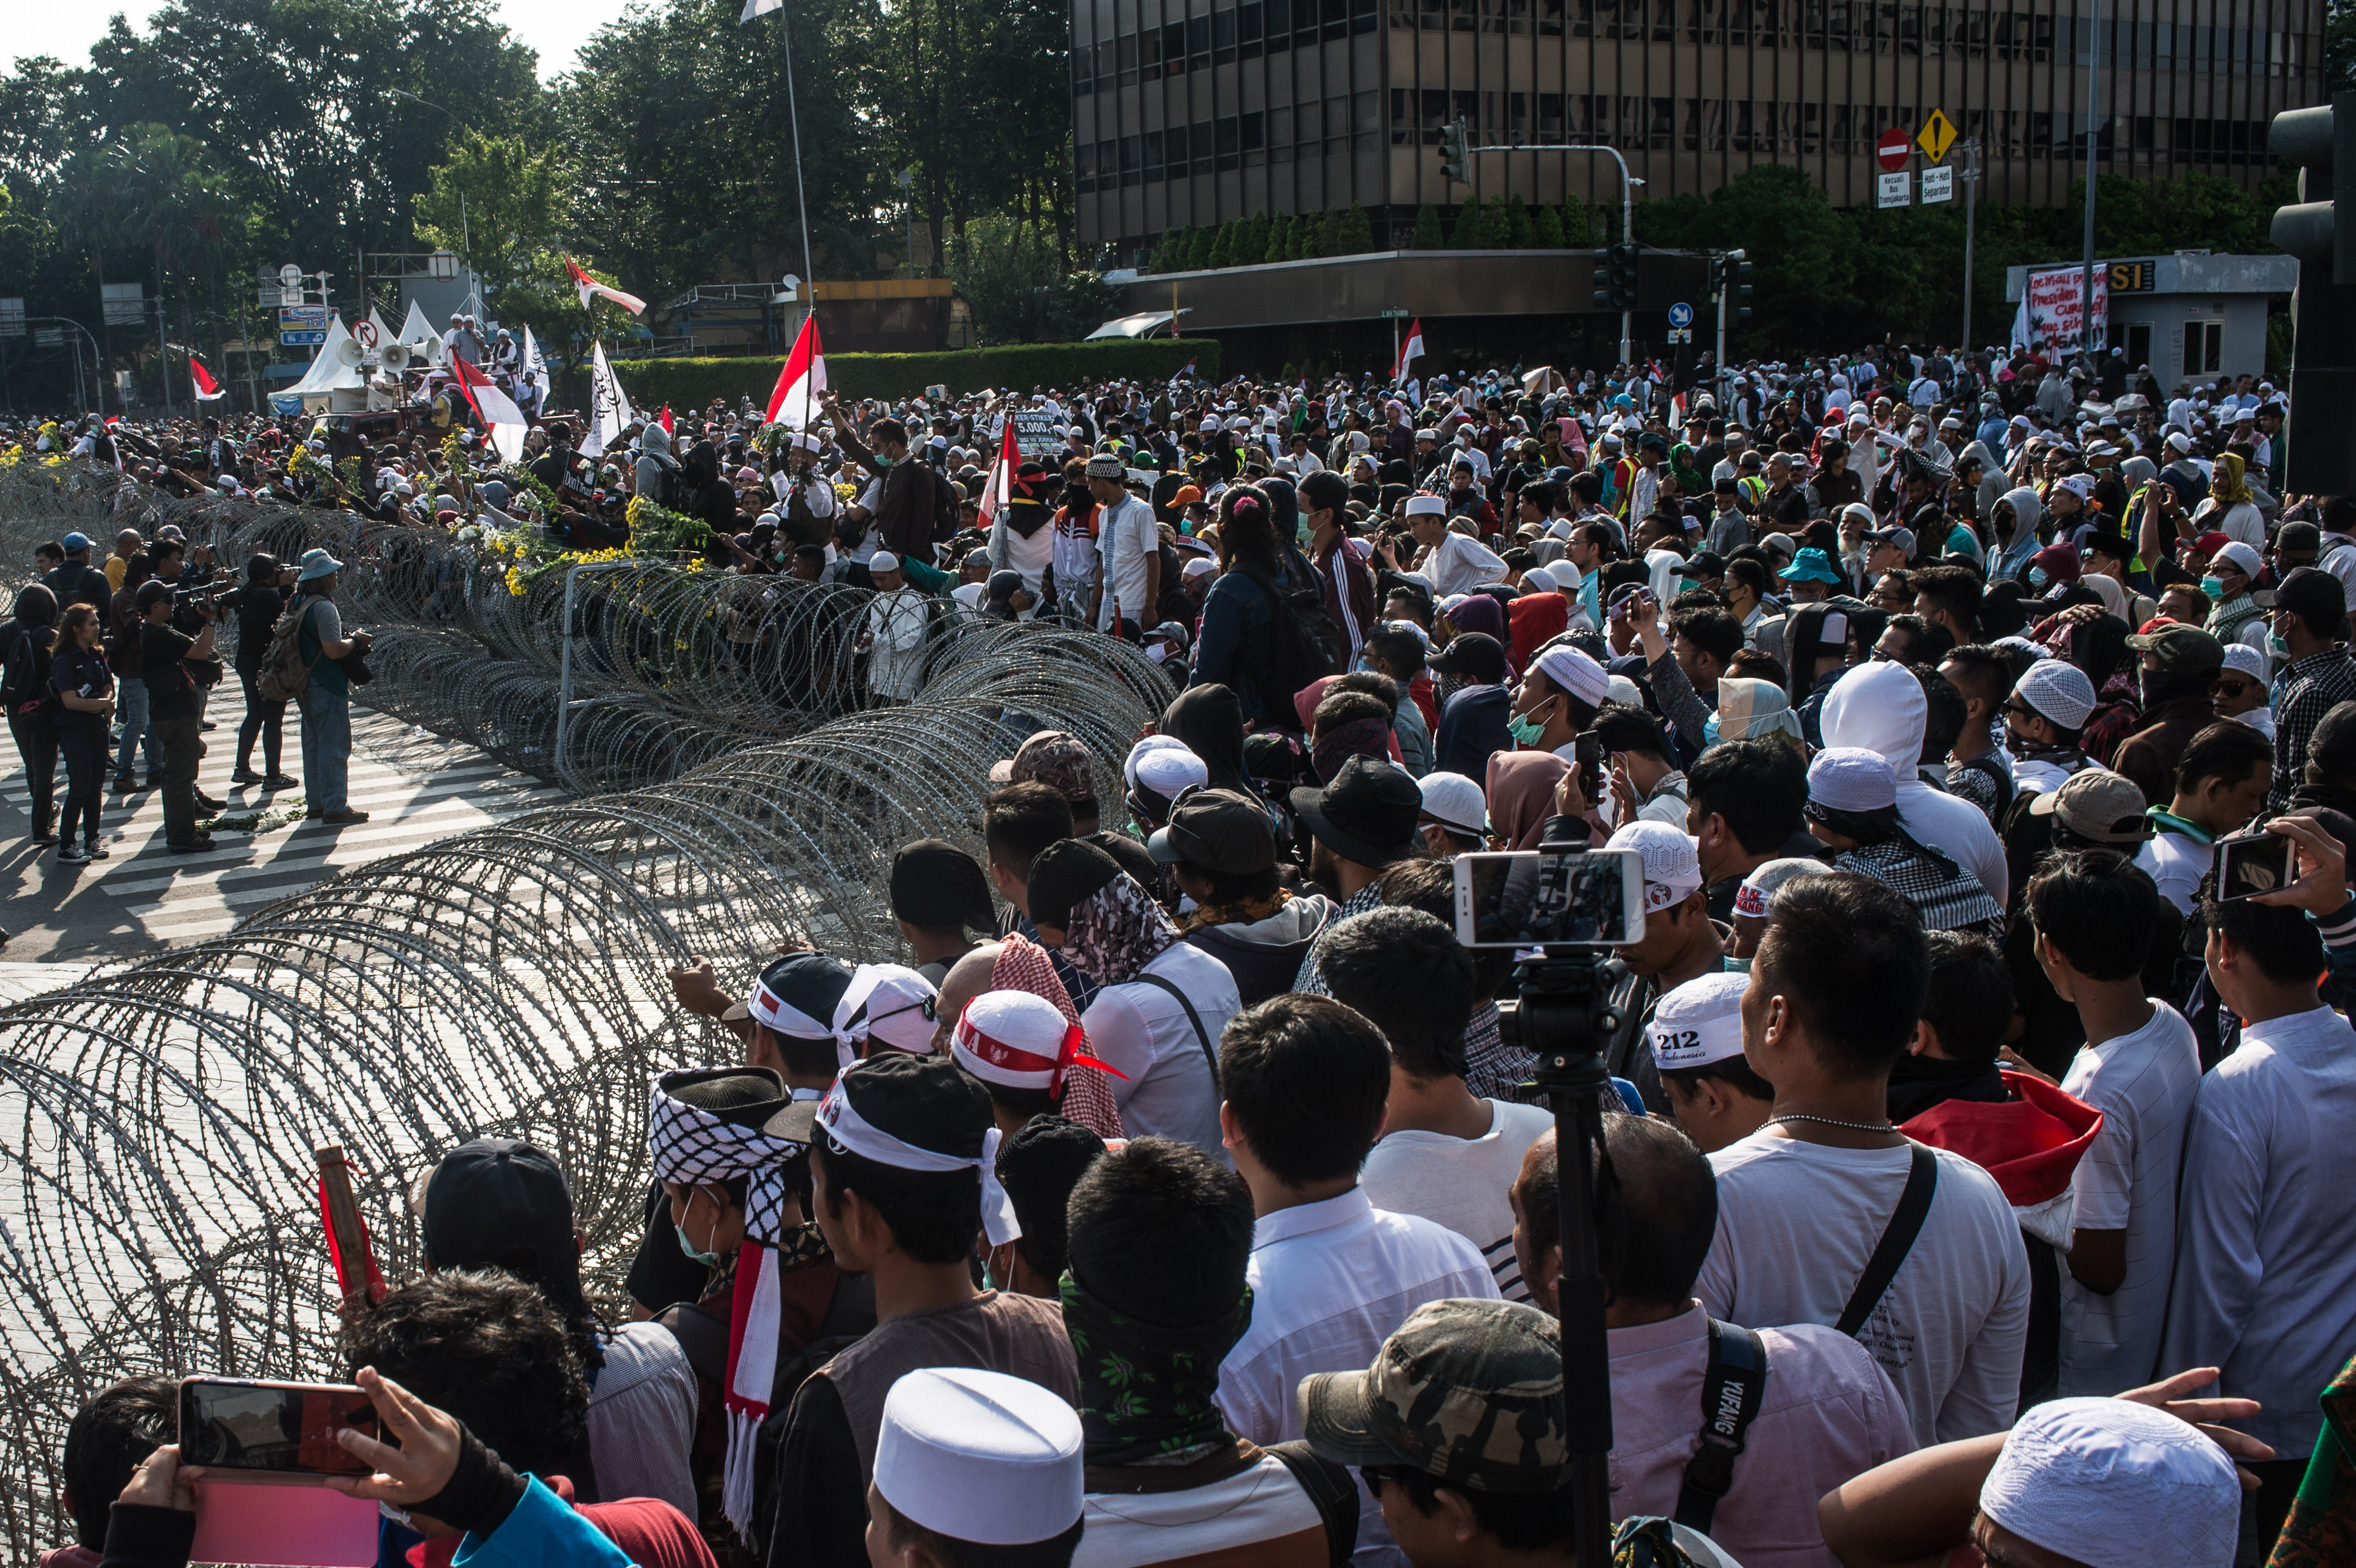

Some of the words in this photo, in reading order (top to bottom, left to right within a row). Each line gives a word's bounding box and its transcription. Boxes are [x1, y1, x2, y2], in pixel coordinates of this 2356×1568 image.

[1884, 174, 1904, 184] Kecuali
[1924, 173, 1935, 183] Hati
[1939, 170, 1950, 181] Hati
[1924, 185, 1950, 198] Separator
[1880, 194, 1909, 204] Transjakarta
[2033, 288, 2078, 308] Presiden
[307, 317, 326, 328] Poin
[564, 470, 581, 492] Don't
[579, 482, 593, 498] Trust
[1656, 1030, 1700, 1049] 212
[1657, 1050, 1706, 1061] Indonesia
[1714, 1380, 1745, 1435] YUFANG
